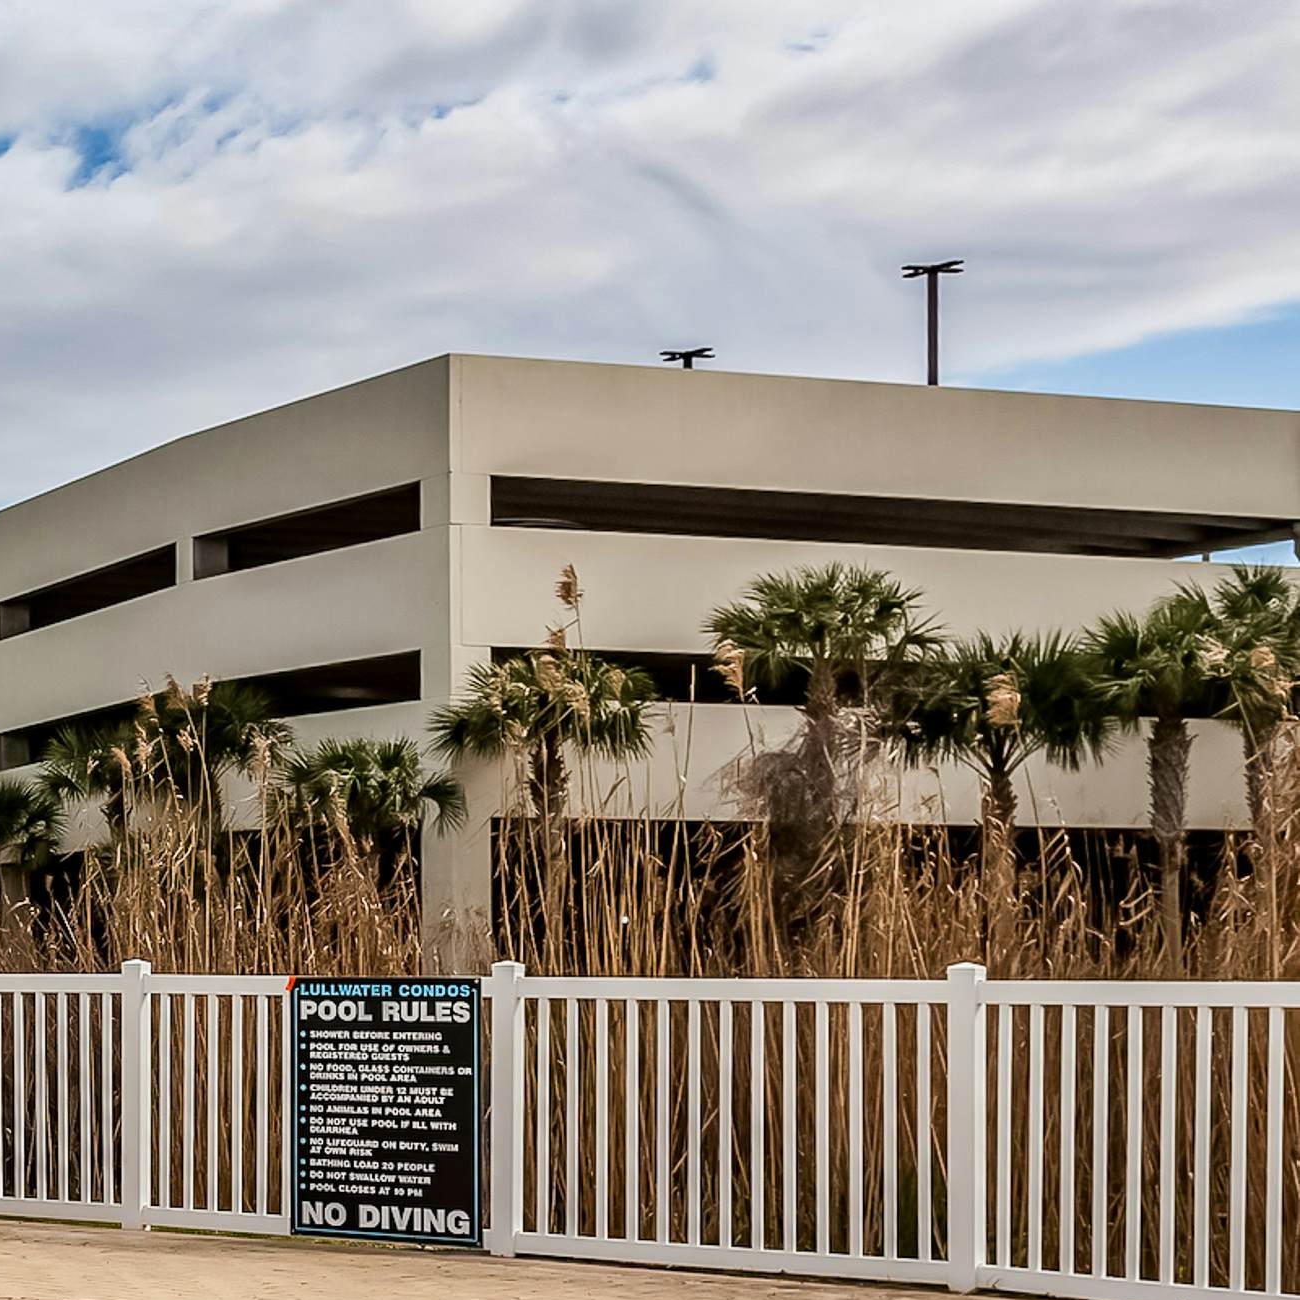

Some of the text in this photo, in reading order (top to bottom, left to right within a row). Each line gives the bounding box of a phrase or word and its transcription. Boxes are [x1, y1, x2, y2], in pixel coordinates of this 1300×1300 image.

[300, 984, 470, 997] LULLWATER CONDOS
[300, 1001, 470, 1022] POOL RULES
[310, 1031, 442, 1040] SHOWER BEFORE ENTERING
[310, 1043, 335, 1051] POOL
[360, 1044, 379, 1052] USE
[398, 1045, 439, 1053] OWNERS
[310, 1051, 409, 1061] REGISTERED GUESTS
[359, 1065, 390, 1073] GLASS
[393, 1065, 454, 1075] CONTAINERS
[458, 1067, 472, 1075] OR
[310, 1072, 344, 1080] DRINKS
[347, 1073, 358, 1081] IN
[390, 1074, 416, 1082] AREA
[310, 1084, 357, 1092] CHILDREN
[360, 1085, 393, 1094] UNDER
[409, 1087, 437, 1096] MUST
[440, 1088, 453, 1096] BE
[310, 1093, 445, 1104] ACCOMPANIED BY AN ADULT
[385, 1108, 412, 1116] POOL
[414, 1108, 442, 1117] AREA
[350, 1118, 368, 1126] USE
[371, 1119, 398, 1128] POOL
[412, 1121, 427, 1129] ILL
[430, 1121, 456, 1130] WITH
[310, 1125, 358, 1135] DIARRHEA
[326, 1138, 379, 1148] LIFEGUARD
[382, 1140, 396, 1149] ON
[432, 1143, 459, 1151] SWIM
[310, 1146, 372, 1156] AT OWN RISK
[310, 1158, 435, 1172] BATHING LOAD 20 PEOPLE
[310, 1171, 431, 1184] DO NOT SWALLOW WATER
[310, 1183, 336, 1191] POOL
[339, 1185, 375, 1194] CLOSES
[378, 1187, 391, 1195] AT
[407, 1188, 423, 1197] PM
[302, 1201, 470, 1235] NO DIVING
